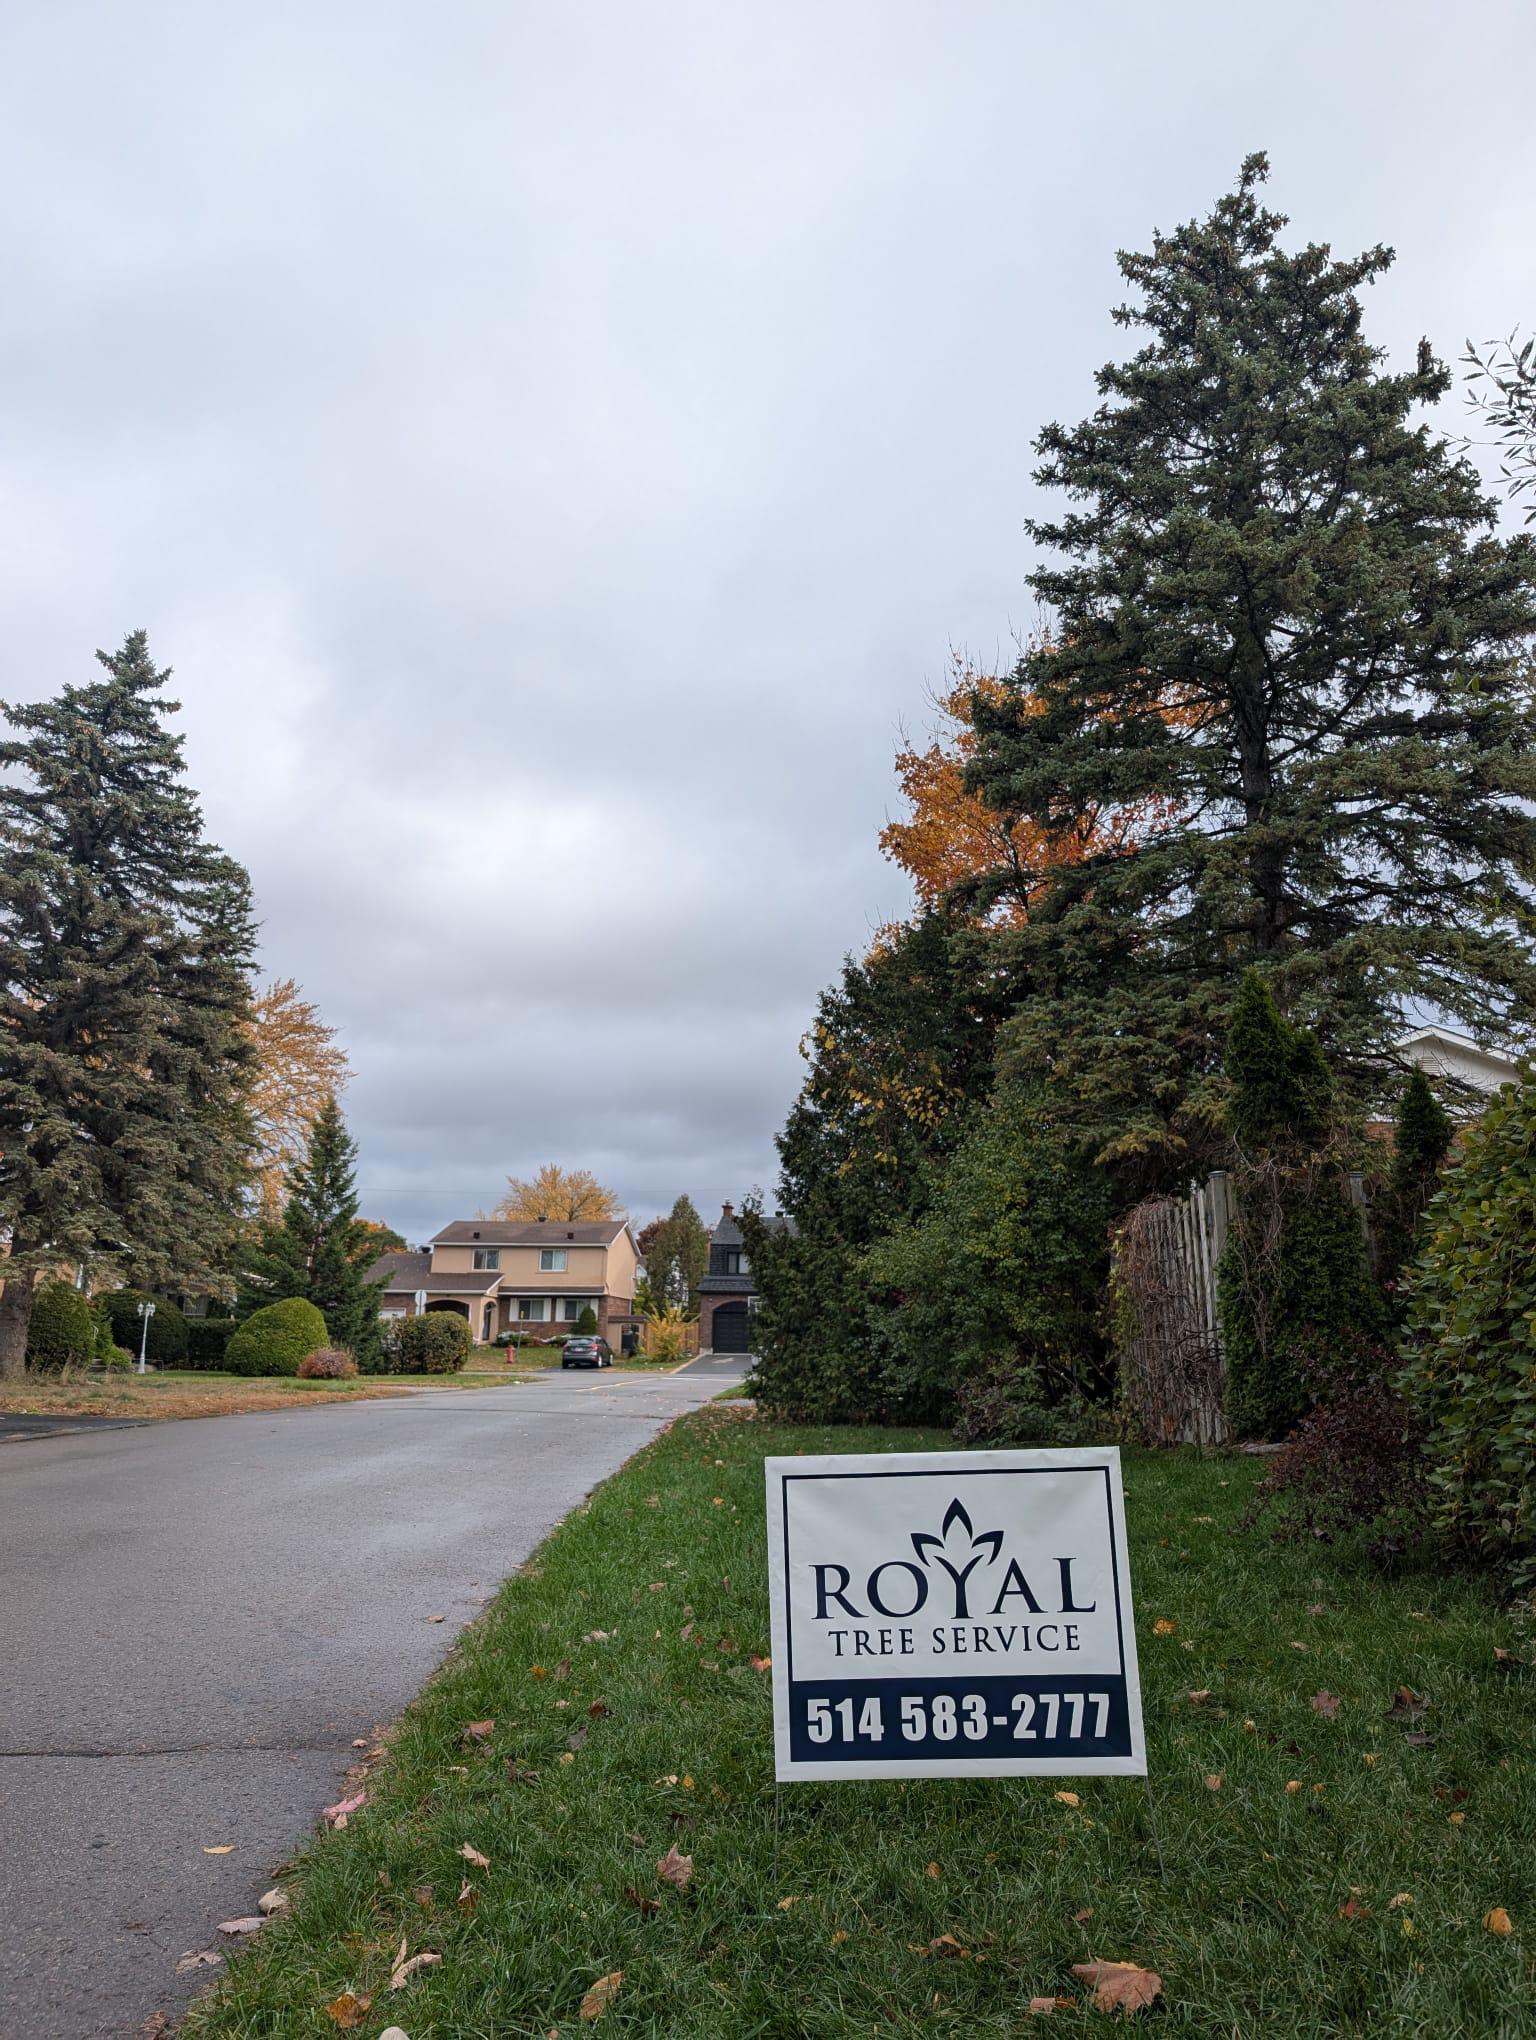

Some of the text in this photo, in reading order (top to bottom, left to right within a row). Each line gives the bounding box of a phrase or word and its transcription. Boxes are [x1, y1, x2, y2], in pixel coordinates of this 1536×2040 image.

[808, 1555, 1097, 1620] ROYAL
[828, 1624, 1081, 1657] TREE SERVICE
[807, 1693, 1110, 1743] 514 583-2777
